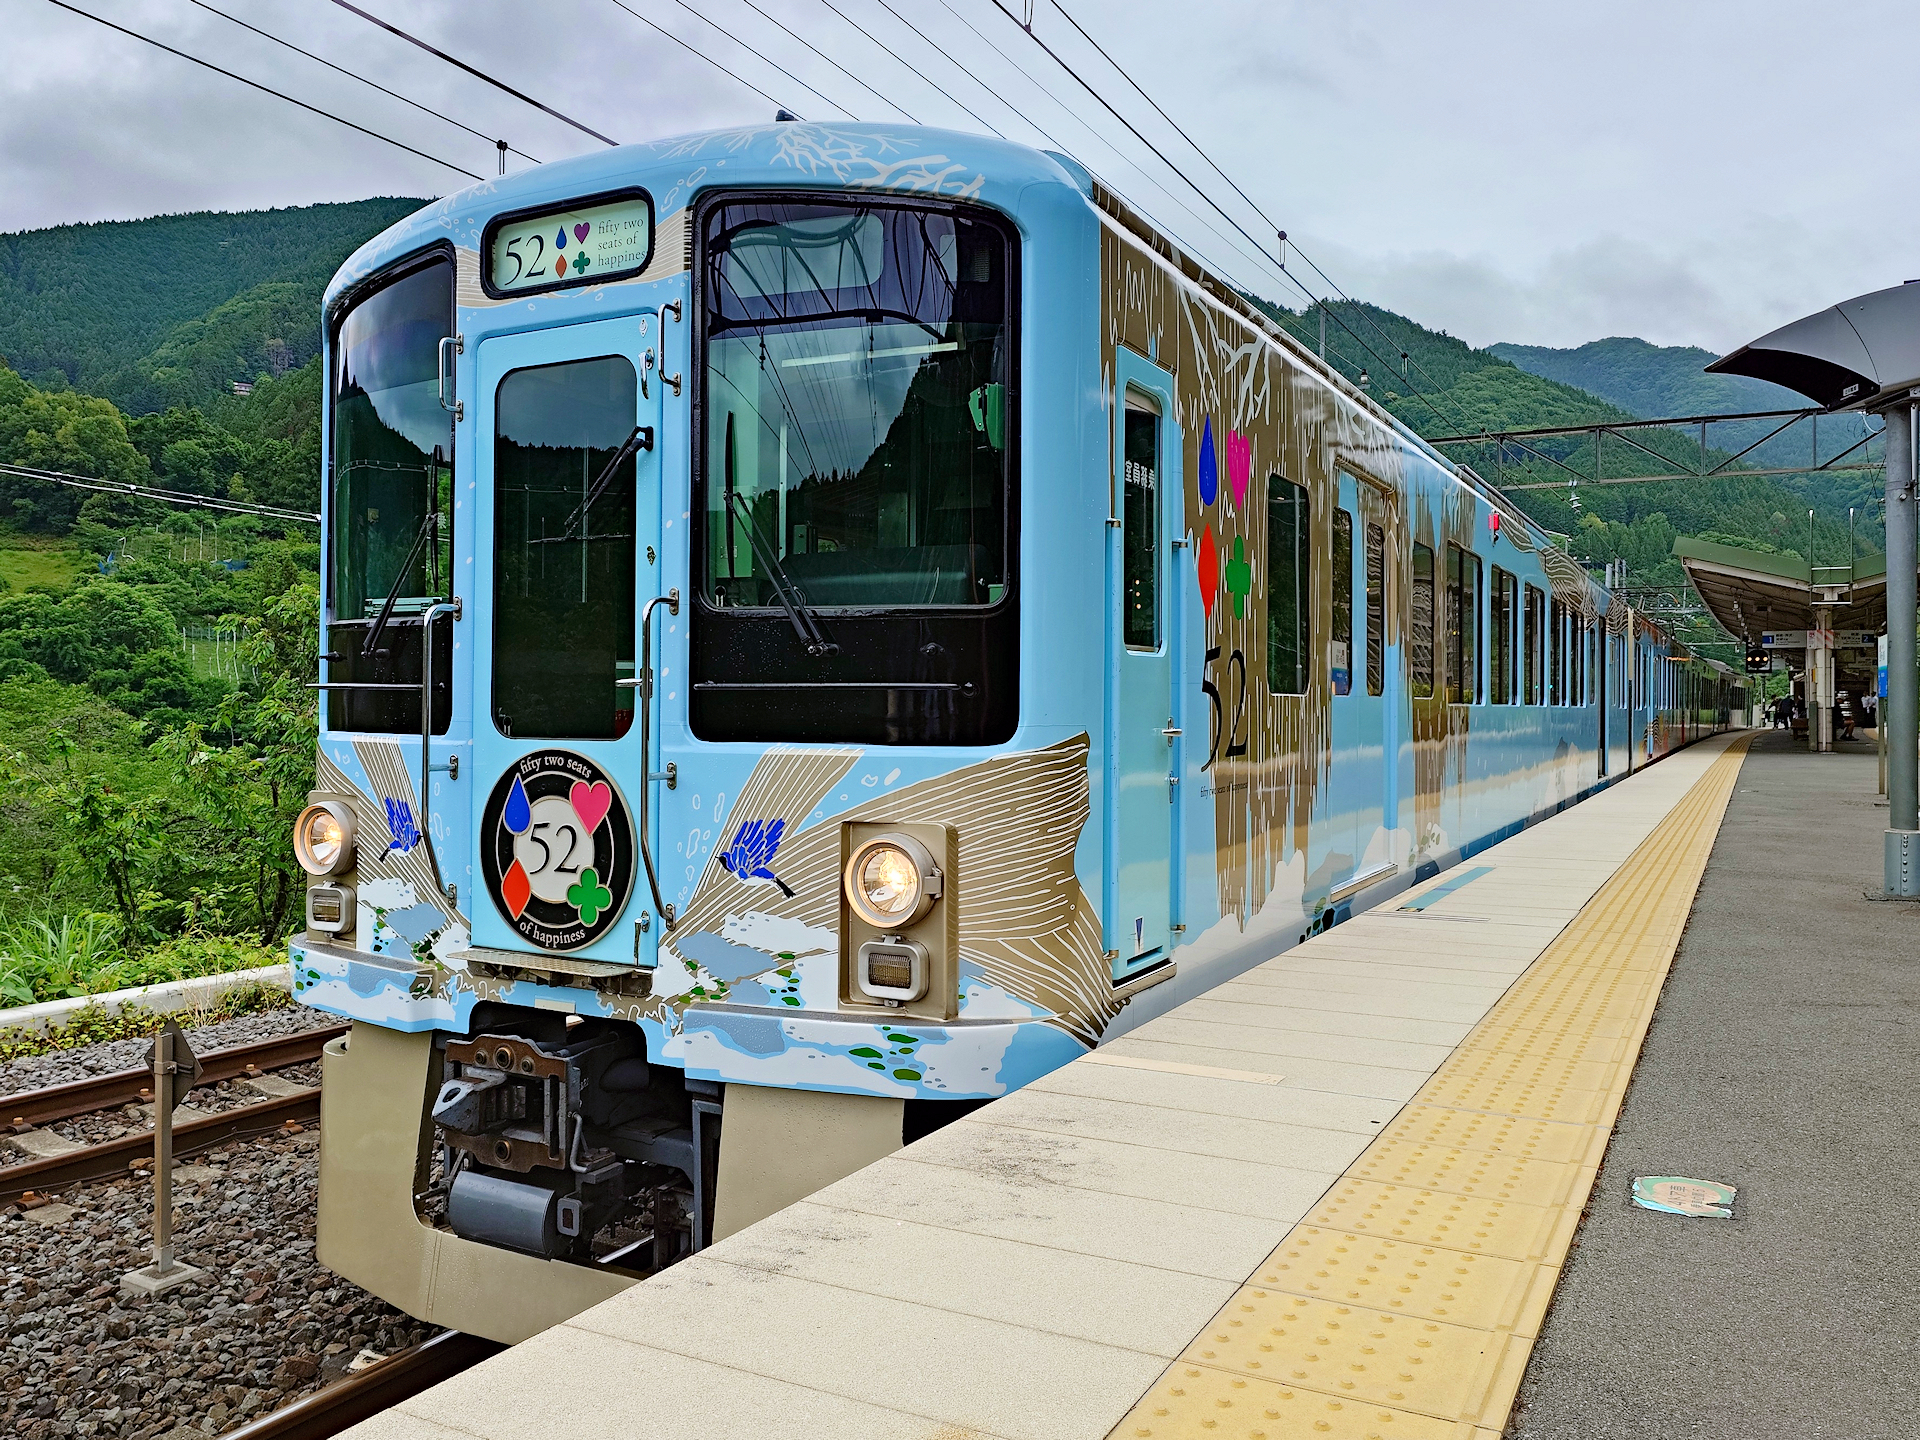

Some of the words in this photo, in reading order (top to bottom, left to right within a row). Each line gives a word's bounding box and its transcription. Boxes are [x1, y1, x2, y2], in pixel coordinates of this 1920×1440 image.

[598, 219, 620, 236] fifty
[623, 218, 644, 230] two
[597, 238, 623, 251] seats
[626, 230, 639, 246] of
[504, 234, 546, 286] 52
[597, 250, 647, 269] happines
[1200, 644, 1249, 773] 52
[519, 756, 541, 775] fifty
[544, 754, 564, 766] two
[566, 758, 592, 778] seats
[529, 821, 580, 875] 52
[519, 922, 532, 936] of
[532, 926, 586, 948] happiness
